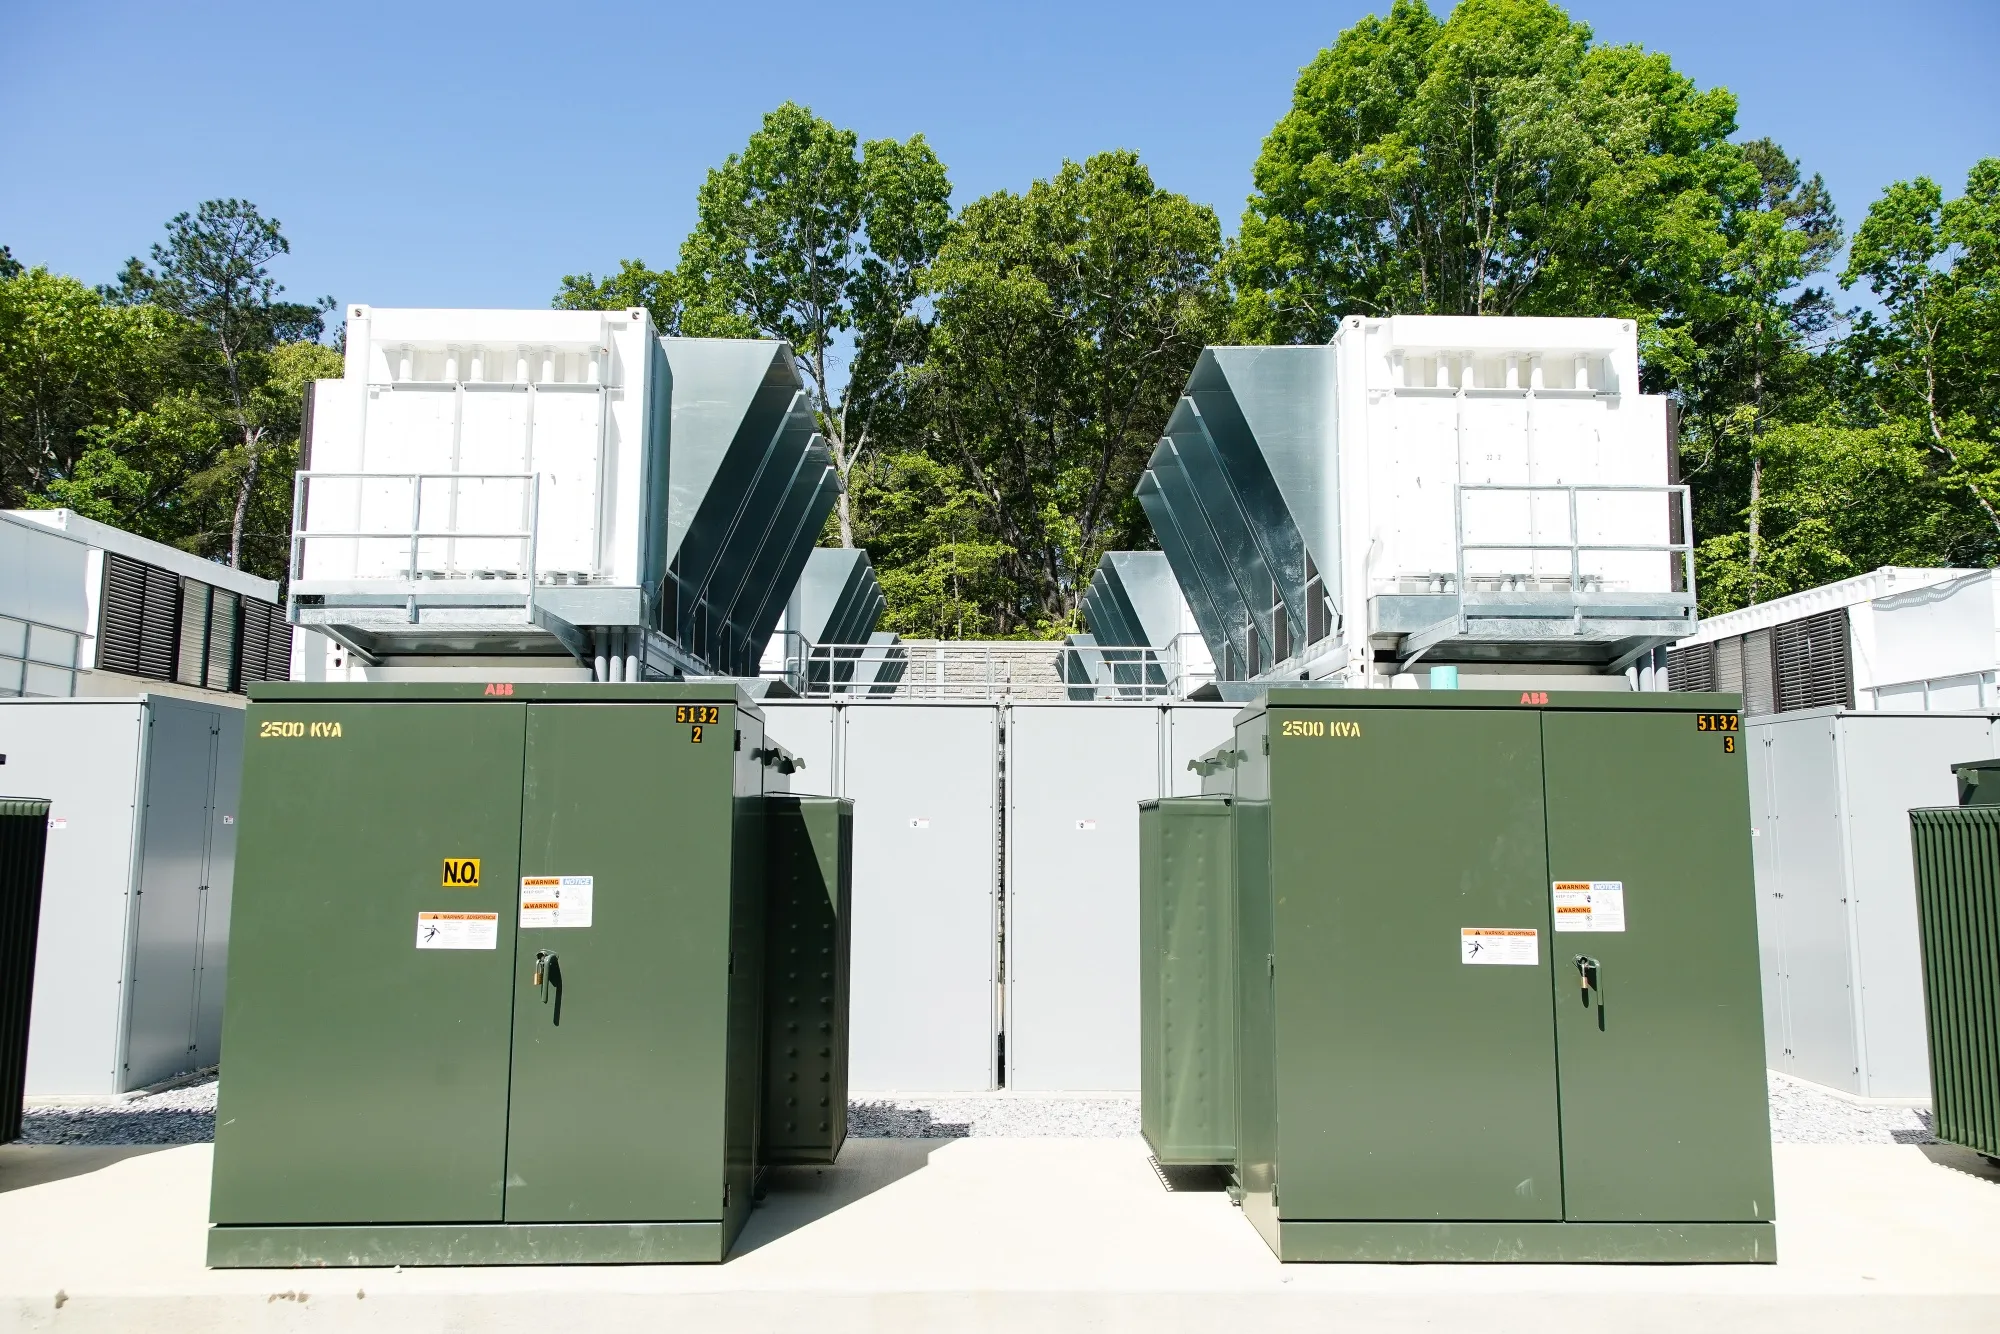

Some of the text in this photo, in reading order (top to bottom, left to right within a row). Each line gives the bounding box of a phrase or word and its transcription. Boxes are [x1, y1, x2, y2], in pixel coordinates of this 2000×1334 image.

[484, 683, 514, 696] ABB
[1520, 692, 1549, 704] ABB
[677, 706, 718, 723] 5132
[260, 721, 342, 738] 2500 KVA
[1282, 721, 1361, 738] 2500 KVA
[1698, 715, 1738, 731] 5132
[692, 726, 702, 742] 2
[1725, 736, 1734, 752] 3
[443, 861, 478, 884] N.O.
